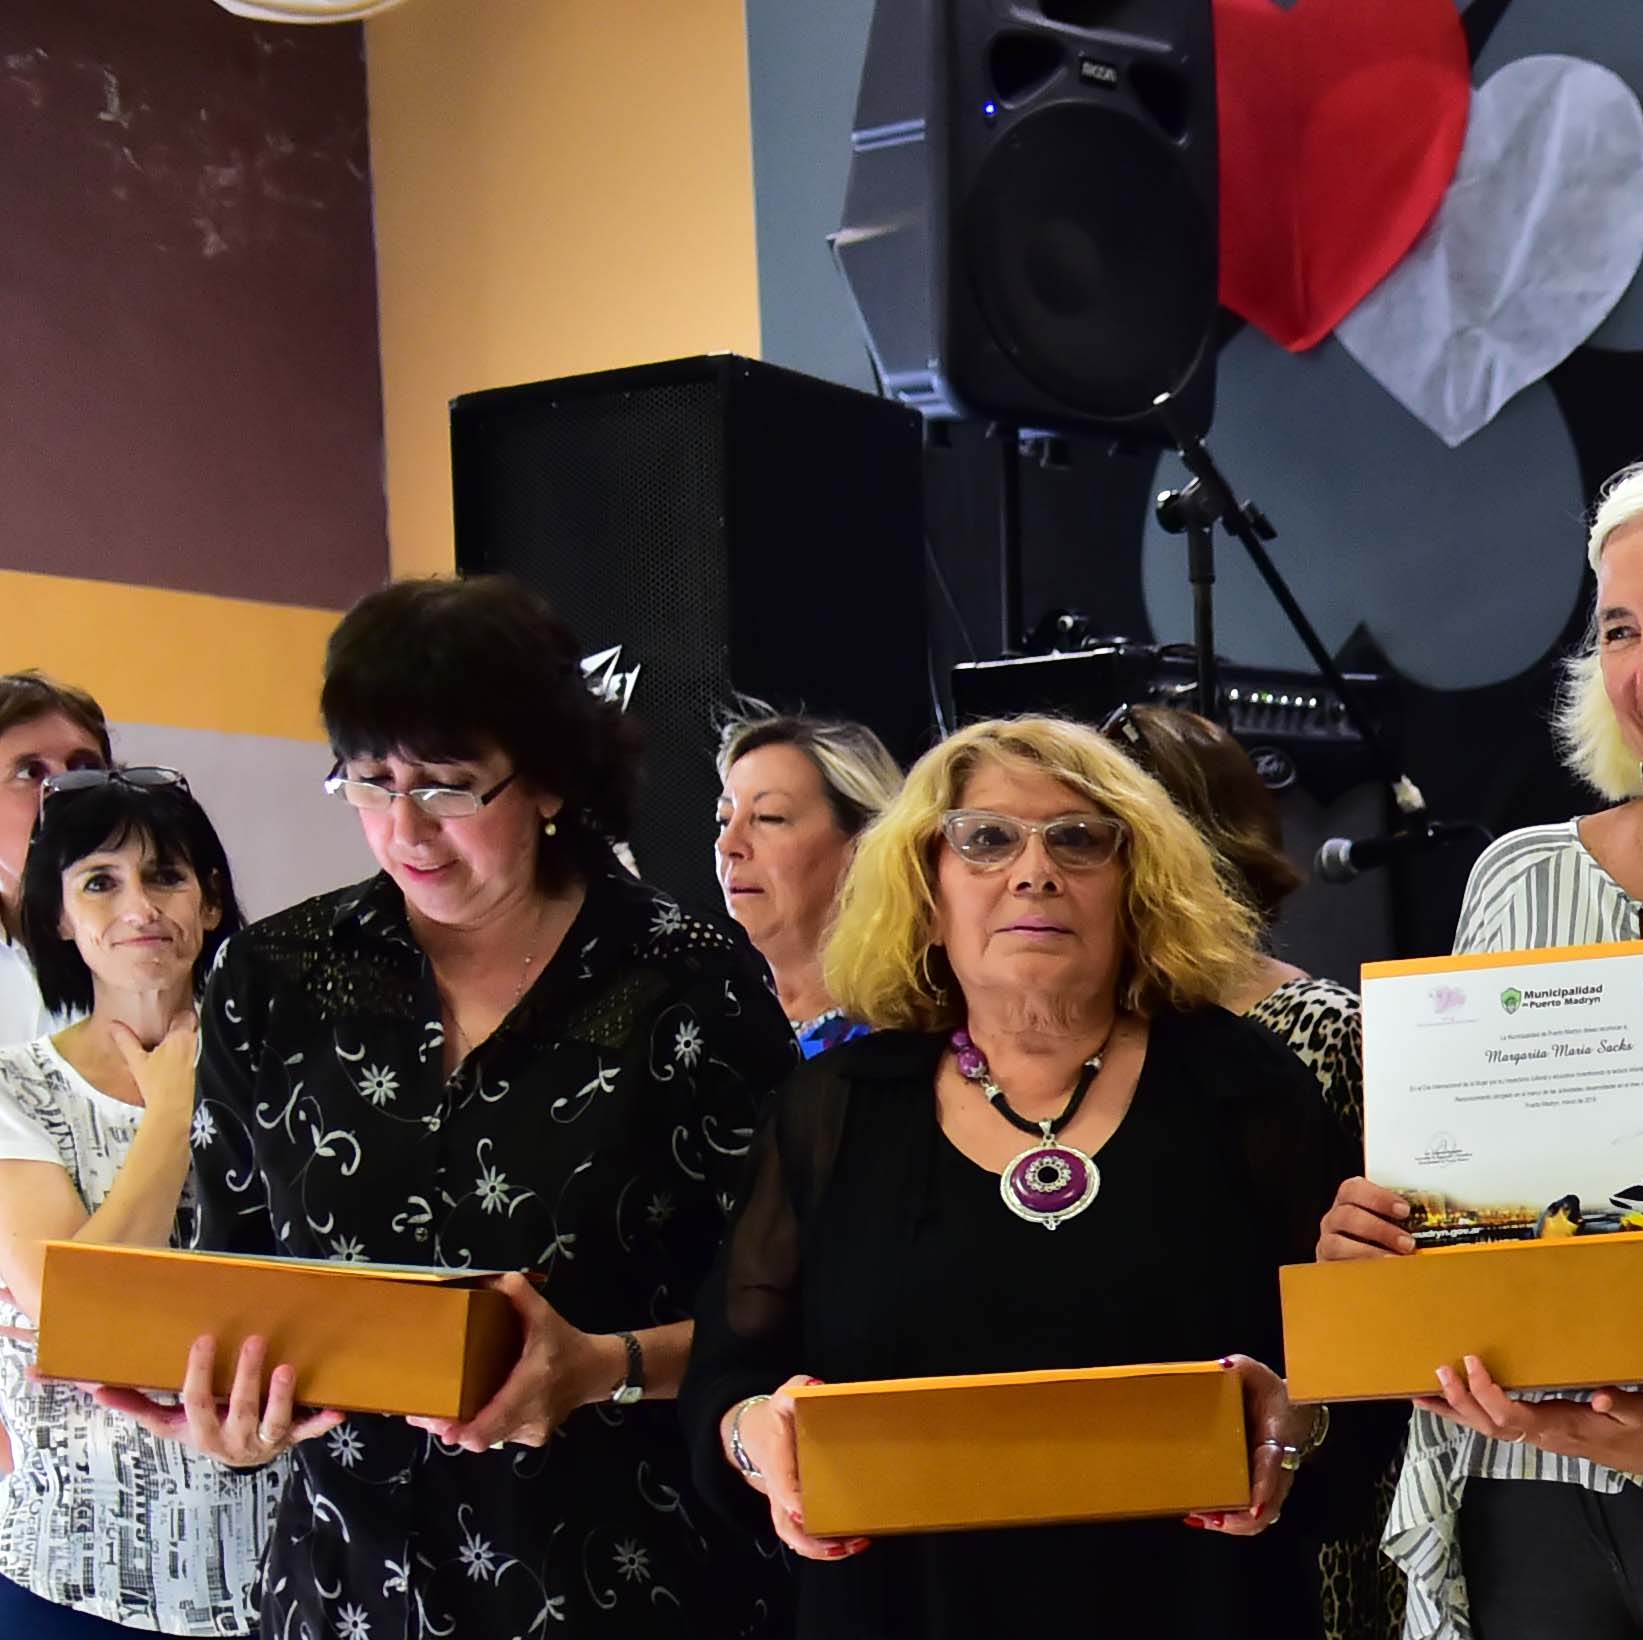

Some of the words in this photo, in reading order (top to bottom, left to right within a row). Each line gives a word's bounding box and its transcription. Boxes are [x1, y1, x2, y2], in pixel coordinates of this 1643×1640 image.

[1523, 984, 1604, 1000] Municipalidad
[1529, 998, 1562, 1009] Puerto
[1563, 996, 1601, 1008] Madryn
[1484, 1048, 1548, 1066] Margarita
